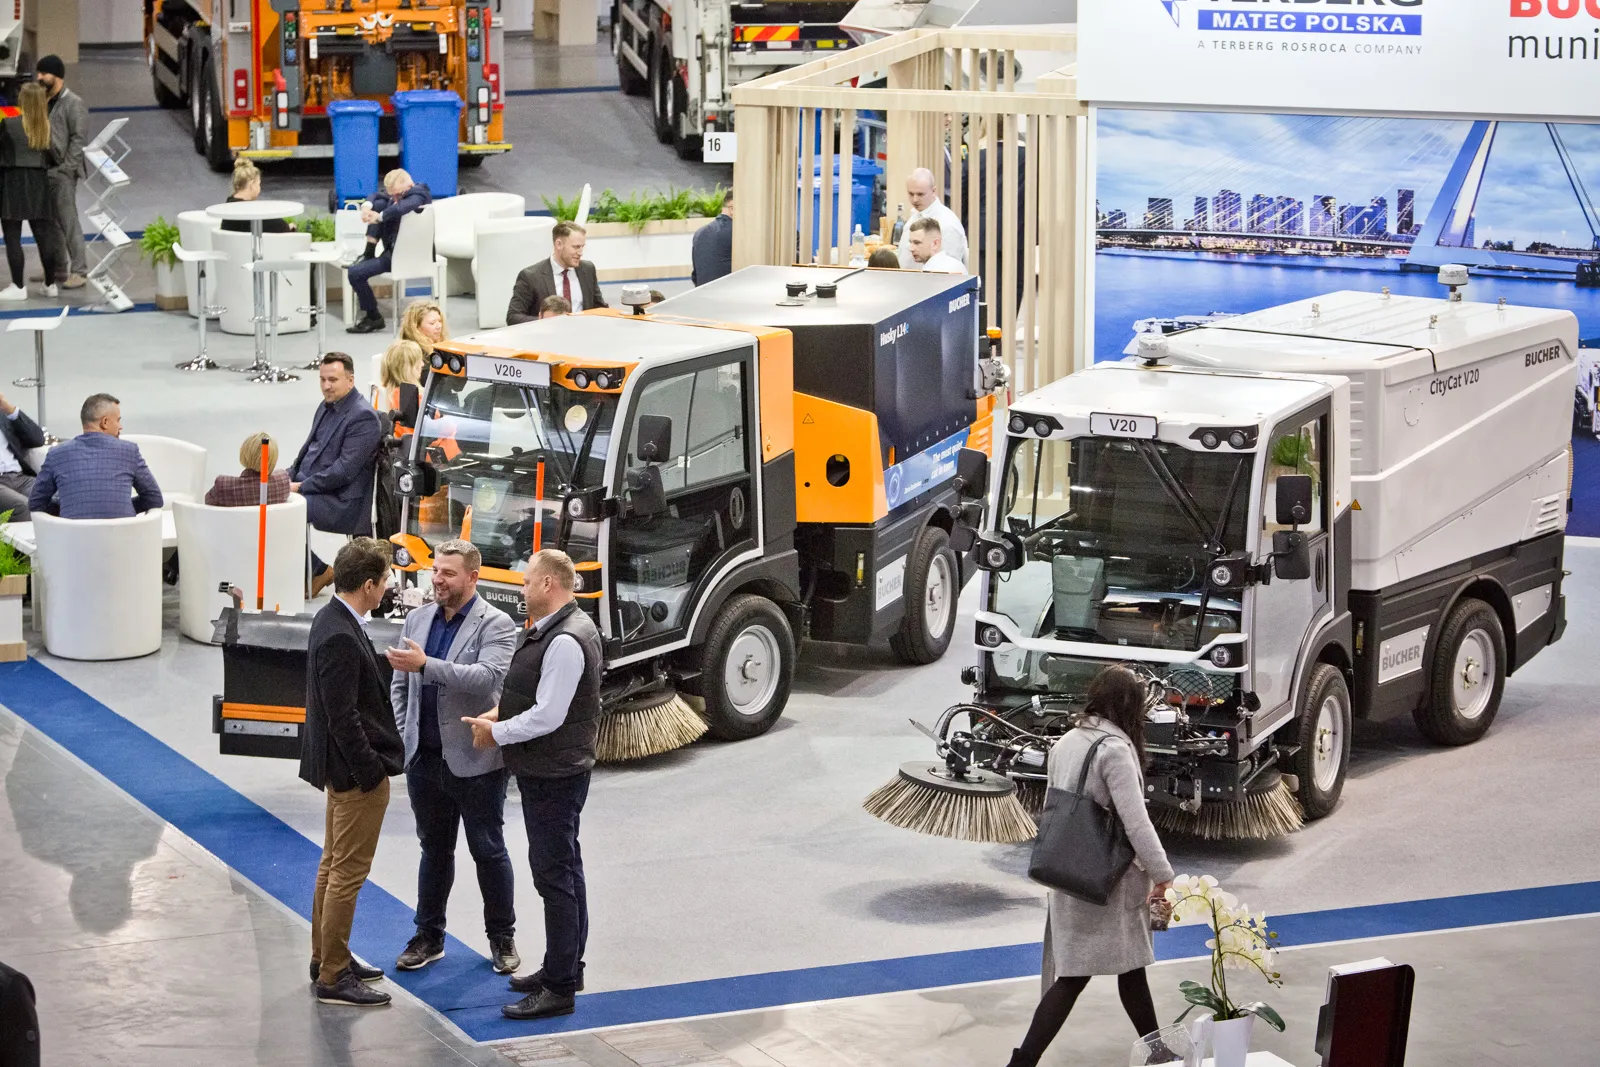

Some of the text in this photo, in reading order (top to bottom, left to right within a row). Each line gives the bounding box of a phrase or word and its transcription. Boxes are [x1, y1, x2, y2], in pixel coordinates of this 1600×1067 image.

[1212, 12, 1406, 33] MATEC POLSKA
[1197, 40, 1423, 55] A TERBERG ROSROCA COMPANY
[1508, 27, 1600, 60] muni
[708, 137, 721, 152] 16
[948, 292, 971, 314] BUCHER
[880, 321, 910, 347] Husky L14e
[1524, 345, 1560, 368] BUCHER
[494, 363, 522, 378] V20e
[1429, 368, 1480, 397] CityCat V20
[1109, 418, 1137, 433] V20
[486, 591, 519, 604] BUCHER
[1382, 645, 1421, 671] BUCHER
